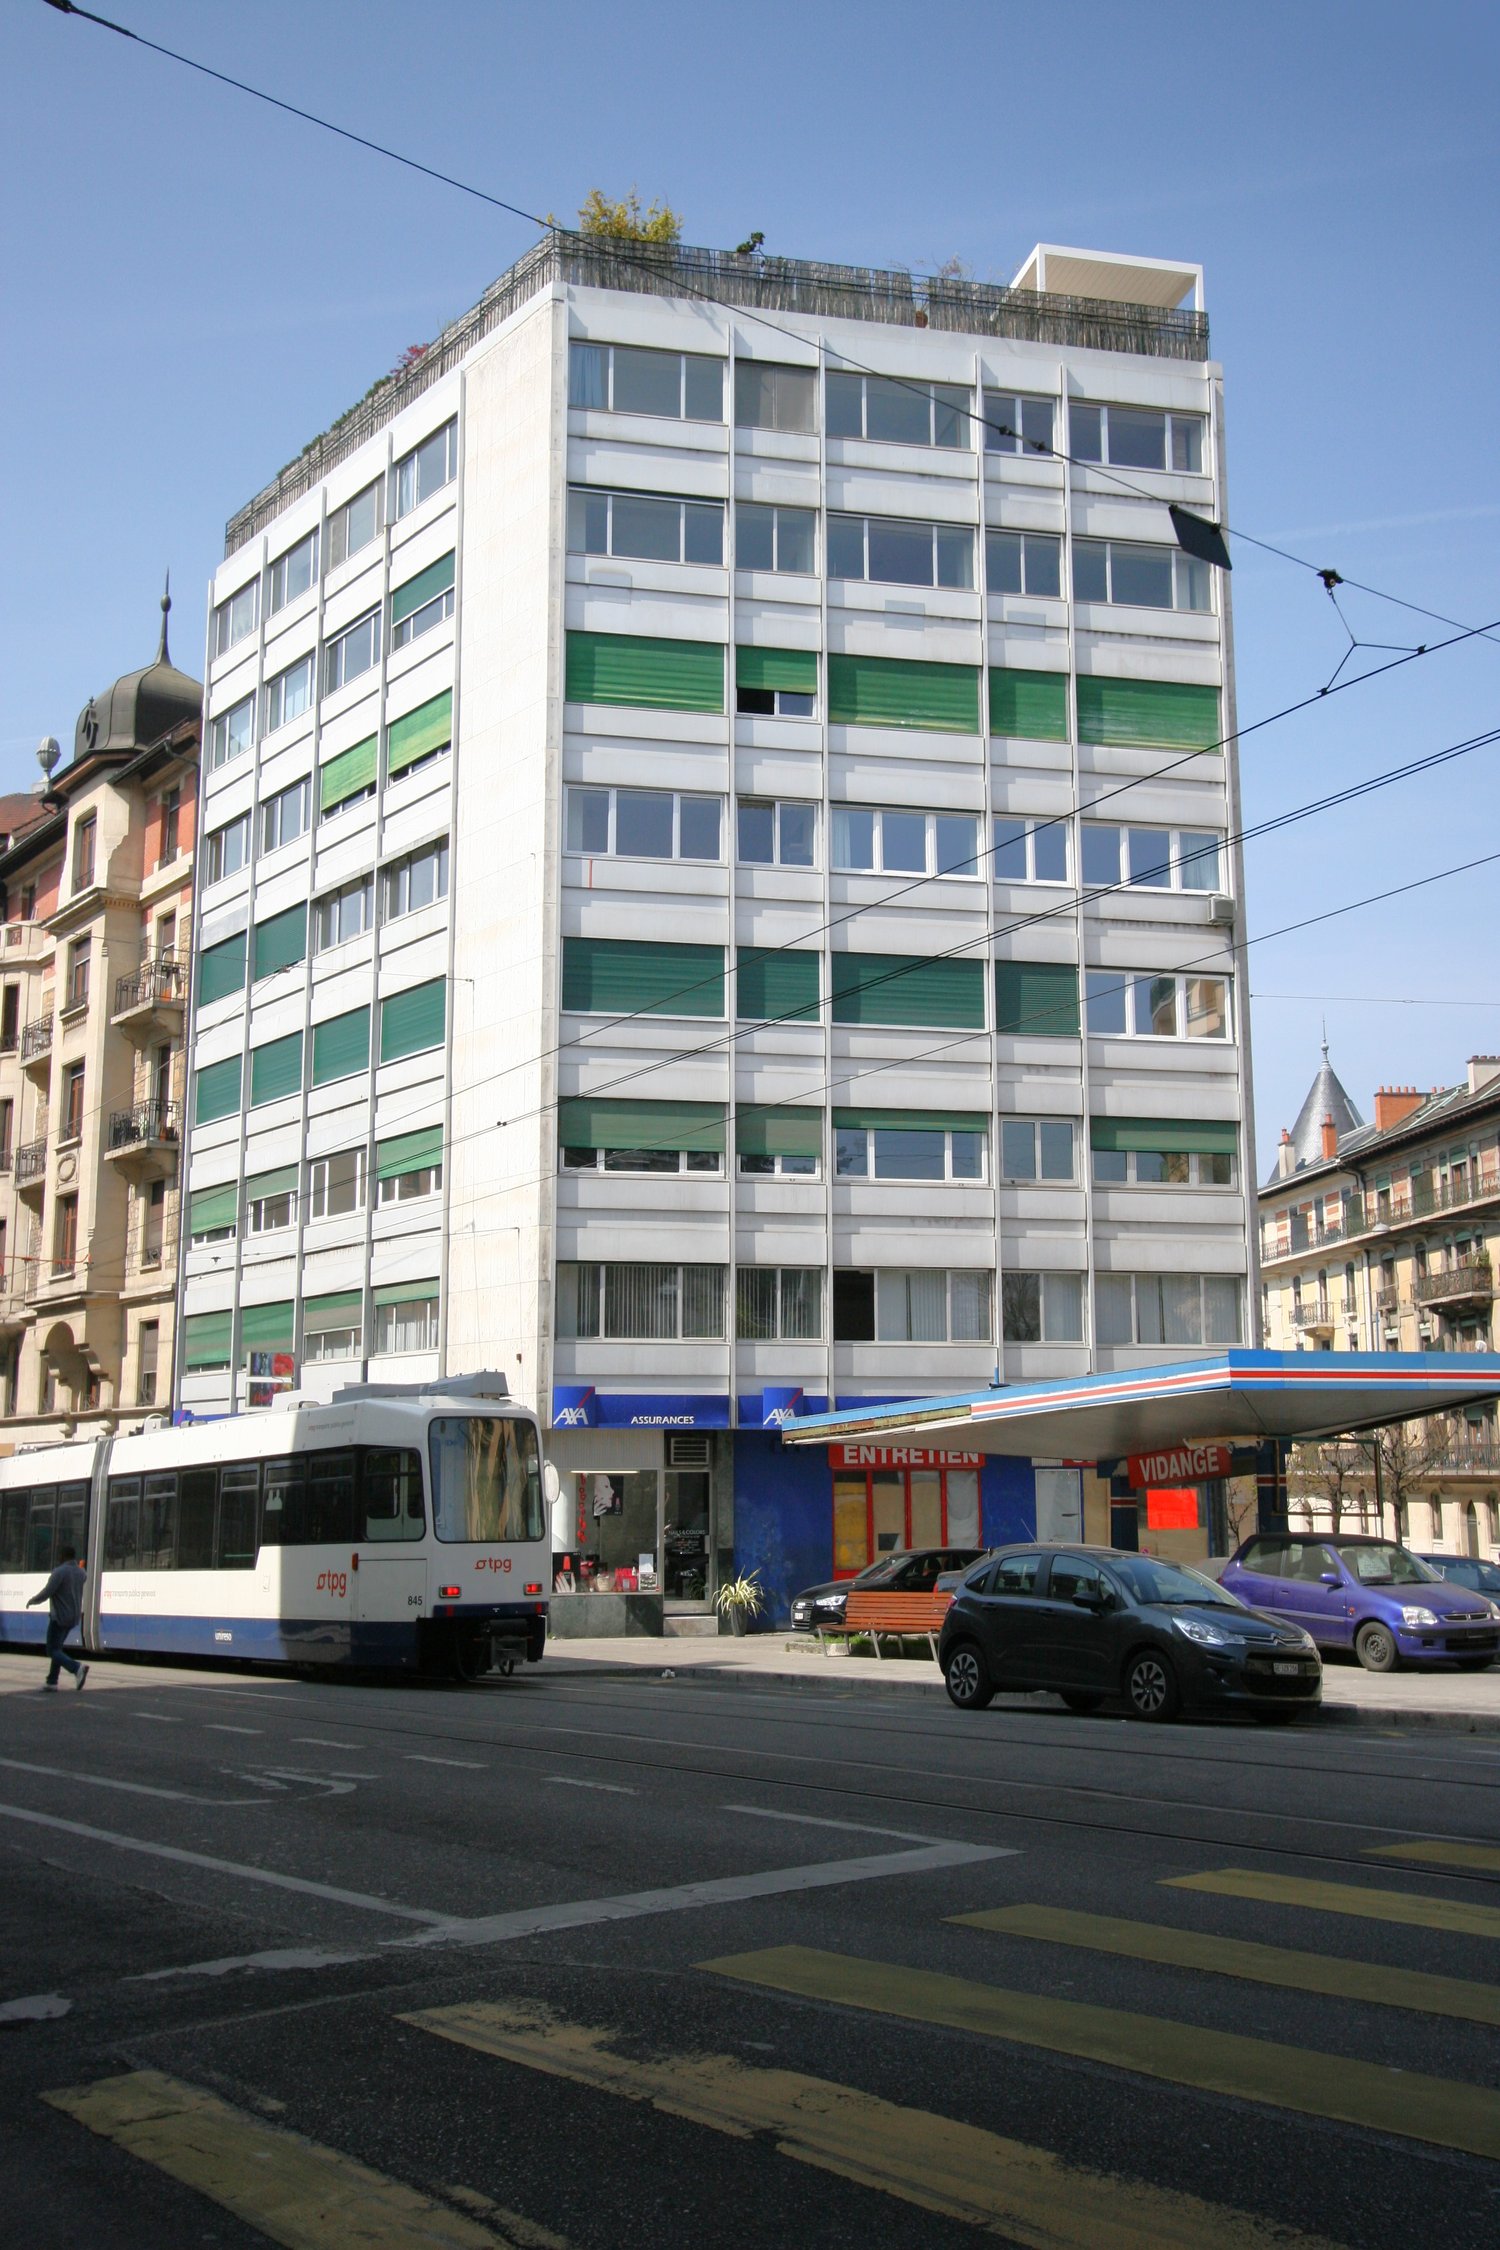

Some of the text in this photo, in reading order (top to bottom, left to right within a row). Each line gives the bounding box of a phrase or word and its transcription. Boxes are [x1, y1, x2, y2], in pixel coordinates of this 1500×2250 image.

[553, 1407, 589, 1425] AXA
[630, 1415, 695, 1425] ASSURANCES
[763, 1408, 796, 1425] AXA
[1139, 1447, 1219, 1482] VIDANGE
[488, 1557, 512, 1573] tpg
[327, 1569, 347, 1598] tpg
[407, 1595, 423, 1606] 845
